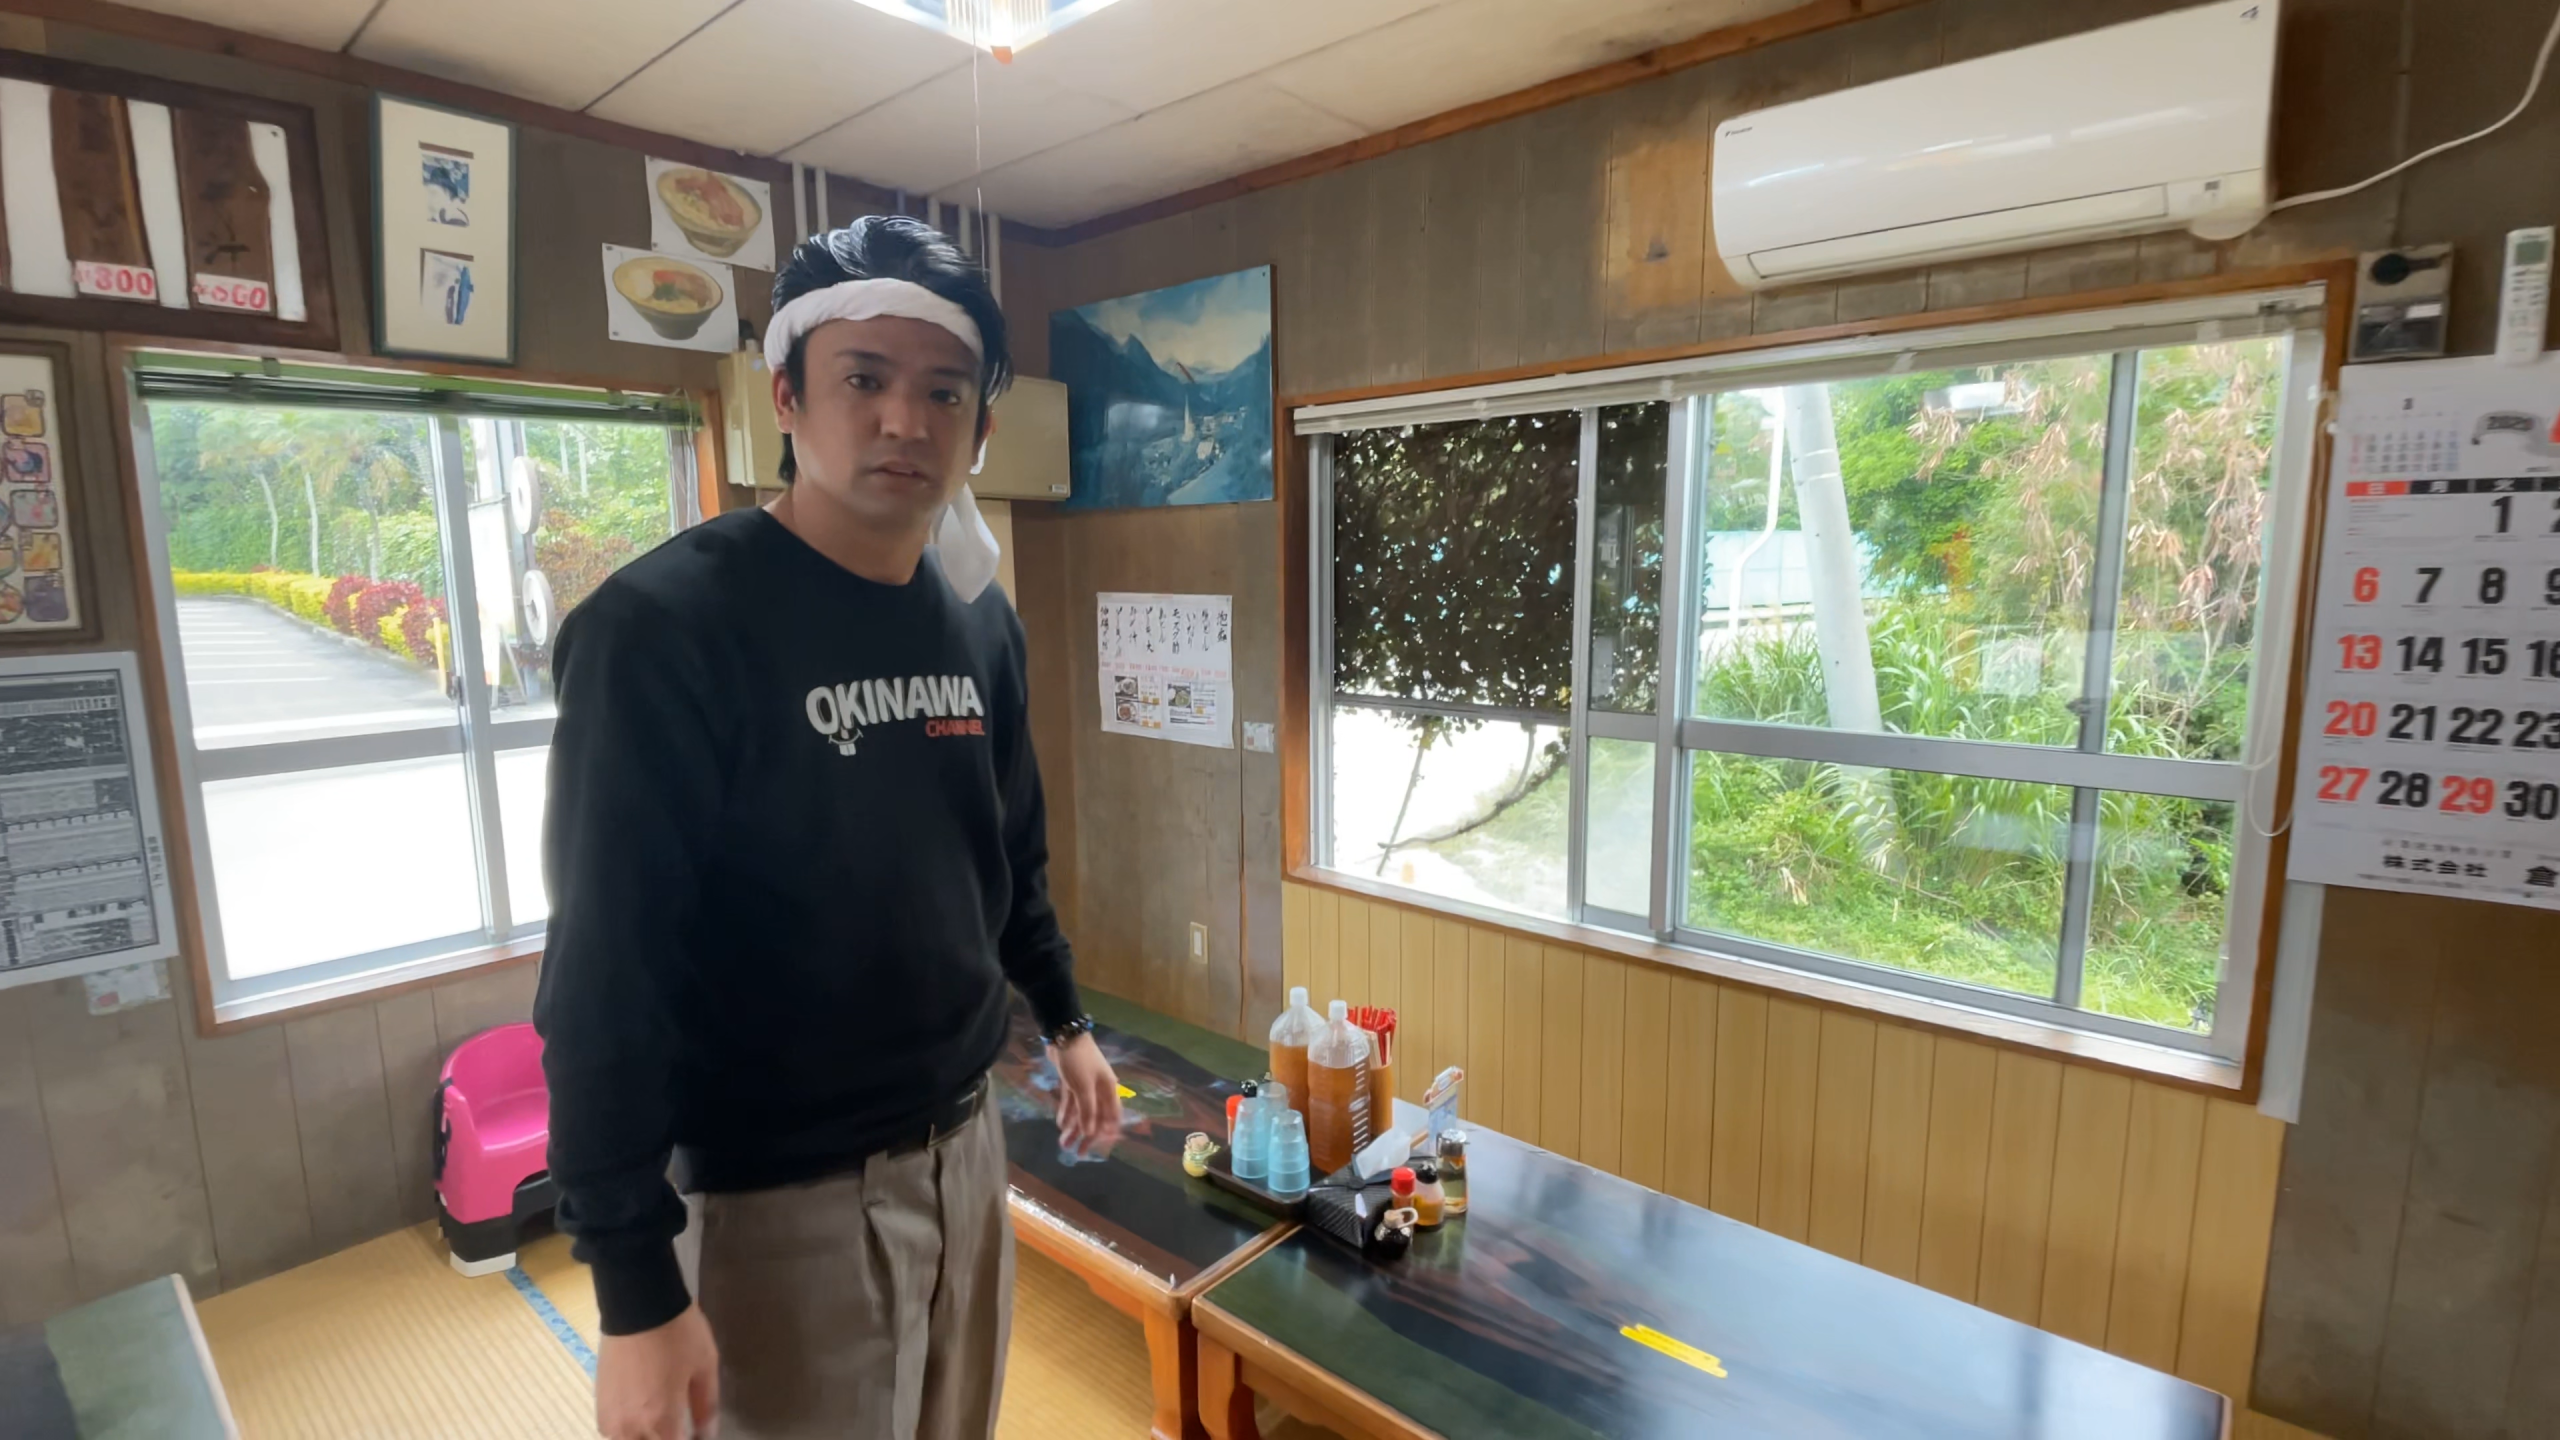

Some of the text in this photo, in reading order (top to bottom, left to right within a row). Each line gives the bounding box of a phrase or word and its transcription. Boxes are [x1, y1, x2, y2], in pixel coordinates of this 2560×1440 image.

[2367, 479, 2515, 495] 日 月 火
[2491, 495, 2514, 533] 1
[2353, 566, 2380, 603] 6
[2416, 566, 2444, 604] 7
[2478, 566, 2507, 605] 8
[2337, 633, 2383, 670] 13
[2396, 635, 2445, 673] 14
[2460, 636, 2509, 675] 15
[805, 675, 985, 736] OKINAWA
[2323, 700, 2560, 750] 20 21 22 23
[2316, 764, 2560, 821] 27 28 29 30
[2381, 854, 2489, 878] 株式会社
